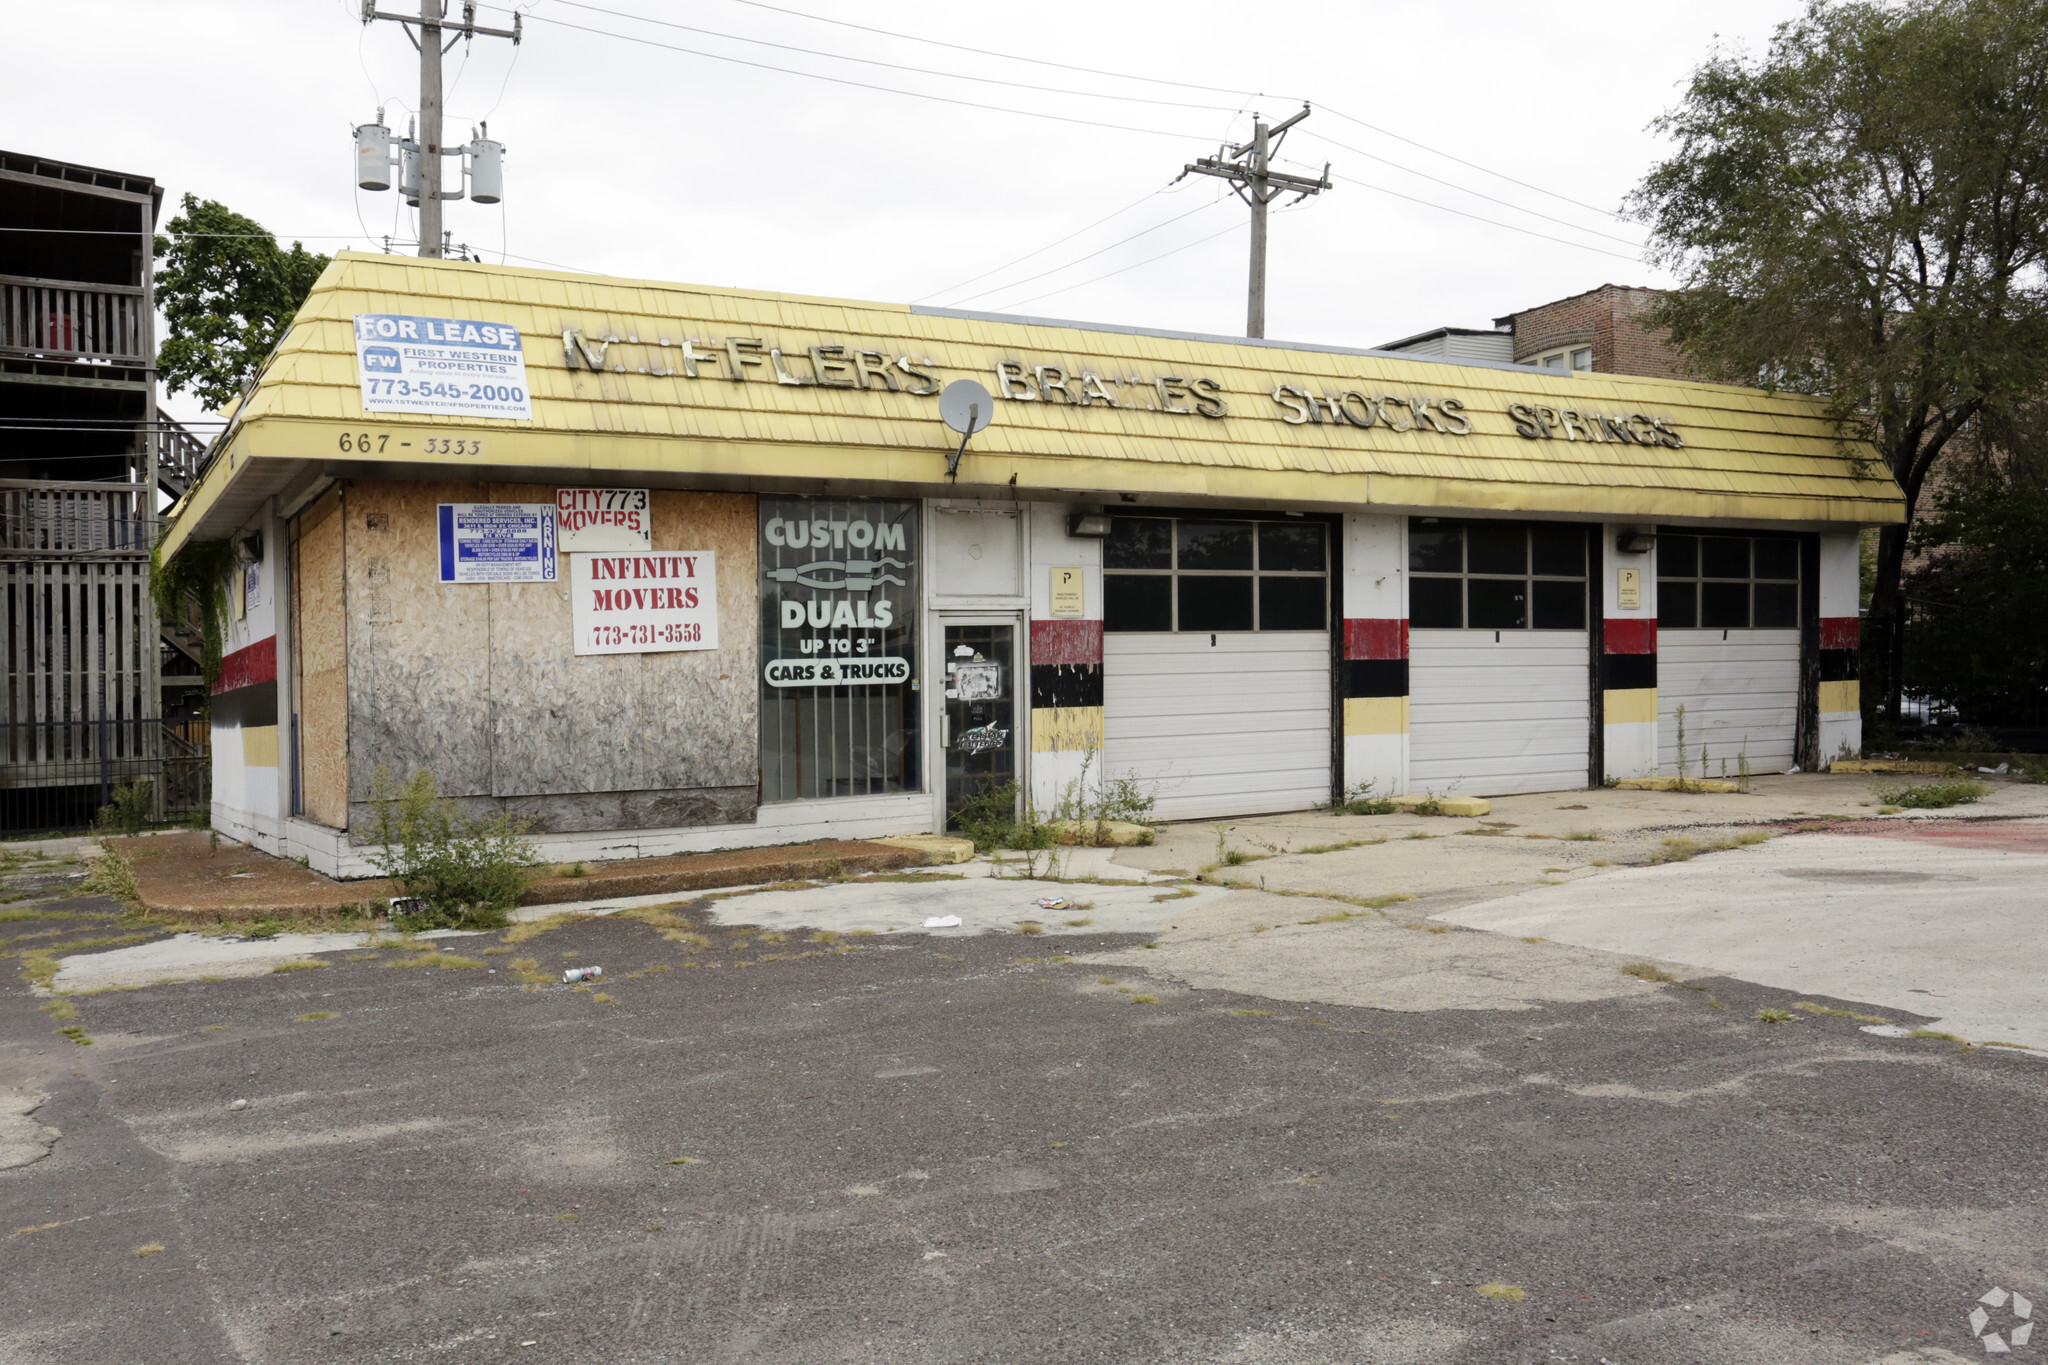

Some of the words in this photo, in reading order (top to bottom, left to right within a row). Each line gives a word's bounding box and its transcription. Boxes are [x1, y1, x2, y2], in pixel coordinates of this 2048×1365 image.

[358, 317, 419, 340] FOR
[427, 322, 517, 348] LEASE
[366, 354, 397, 368] FW
[404, 347, 445, 358] FIRST
[449, 351, 517, 363] WESTERN
[409, 368, 433, 377] Adding
[418, 361, 507, 374] PROPERTIES
[367, 378, 524, 403] 773-545-2000
[996, 359, 1229, 418] BRAES
[1272, 385, 1472, 435] SHOCKS
[1509, 403, 1684, 449] SPRINGS
[558, 490, 604, 510] CITY
[604, 490, 647, 510] 773
[558, 511, 641, 531] MOVERS
[541, 505, 555, 579] WARNING
[765, 517, 906, 551] CUSTOM
[591, 556, 698, 580] INFINITY
[592, 587, 699, 611] MOVERS
[781, 600, 893, 629] DUALS
[593, 623, 702, 646] 773-731-3558
[800, 638, 825, 654] UP
[828, 638, 851, 653] TO
[769, 665, 815, 681] CARS
[820, 665, 835, 680] &
[839, 663, 906, 680] TRUCKS
